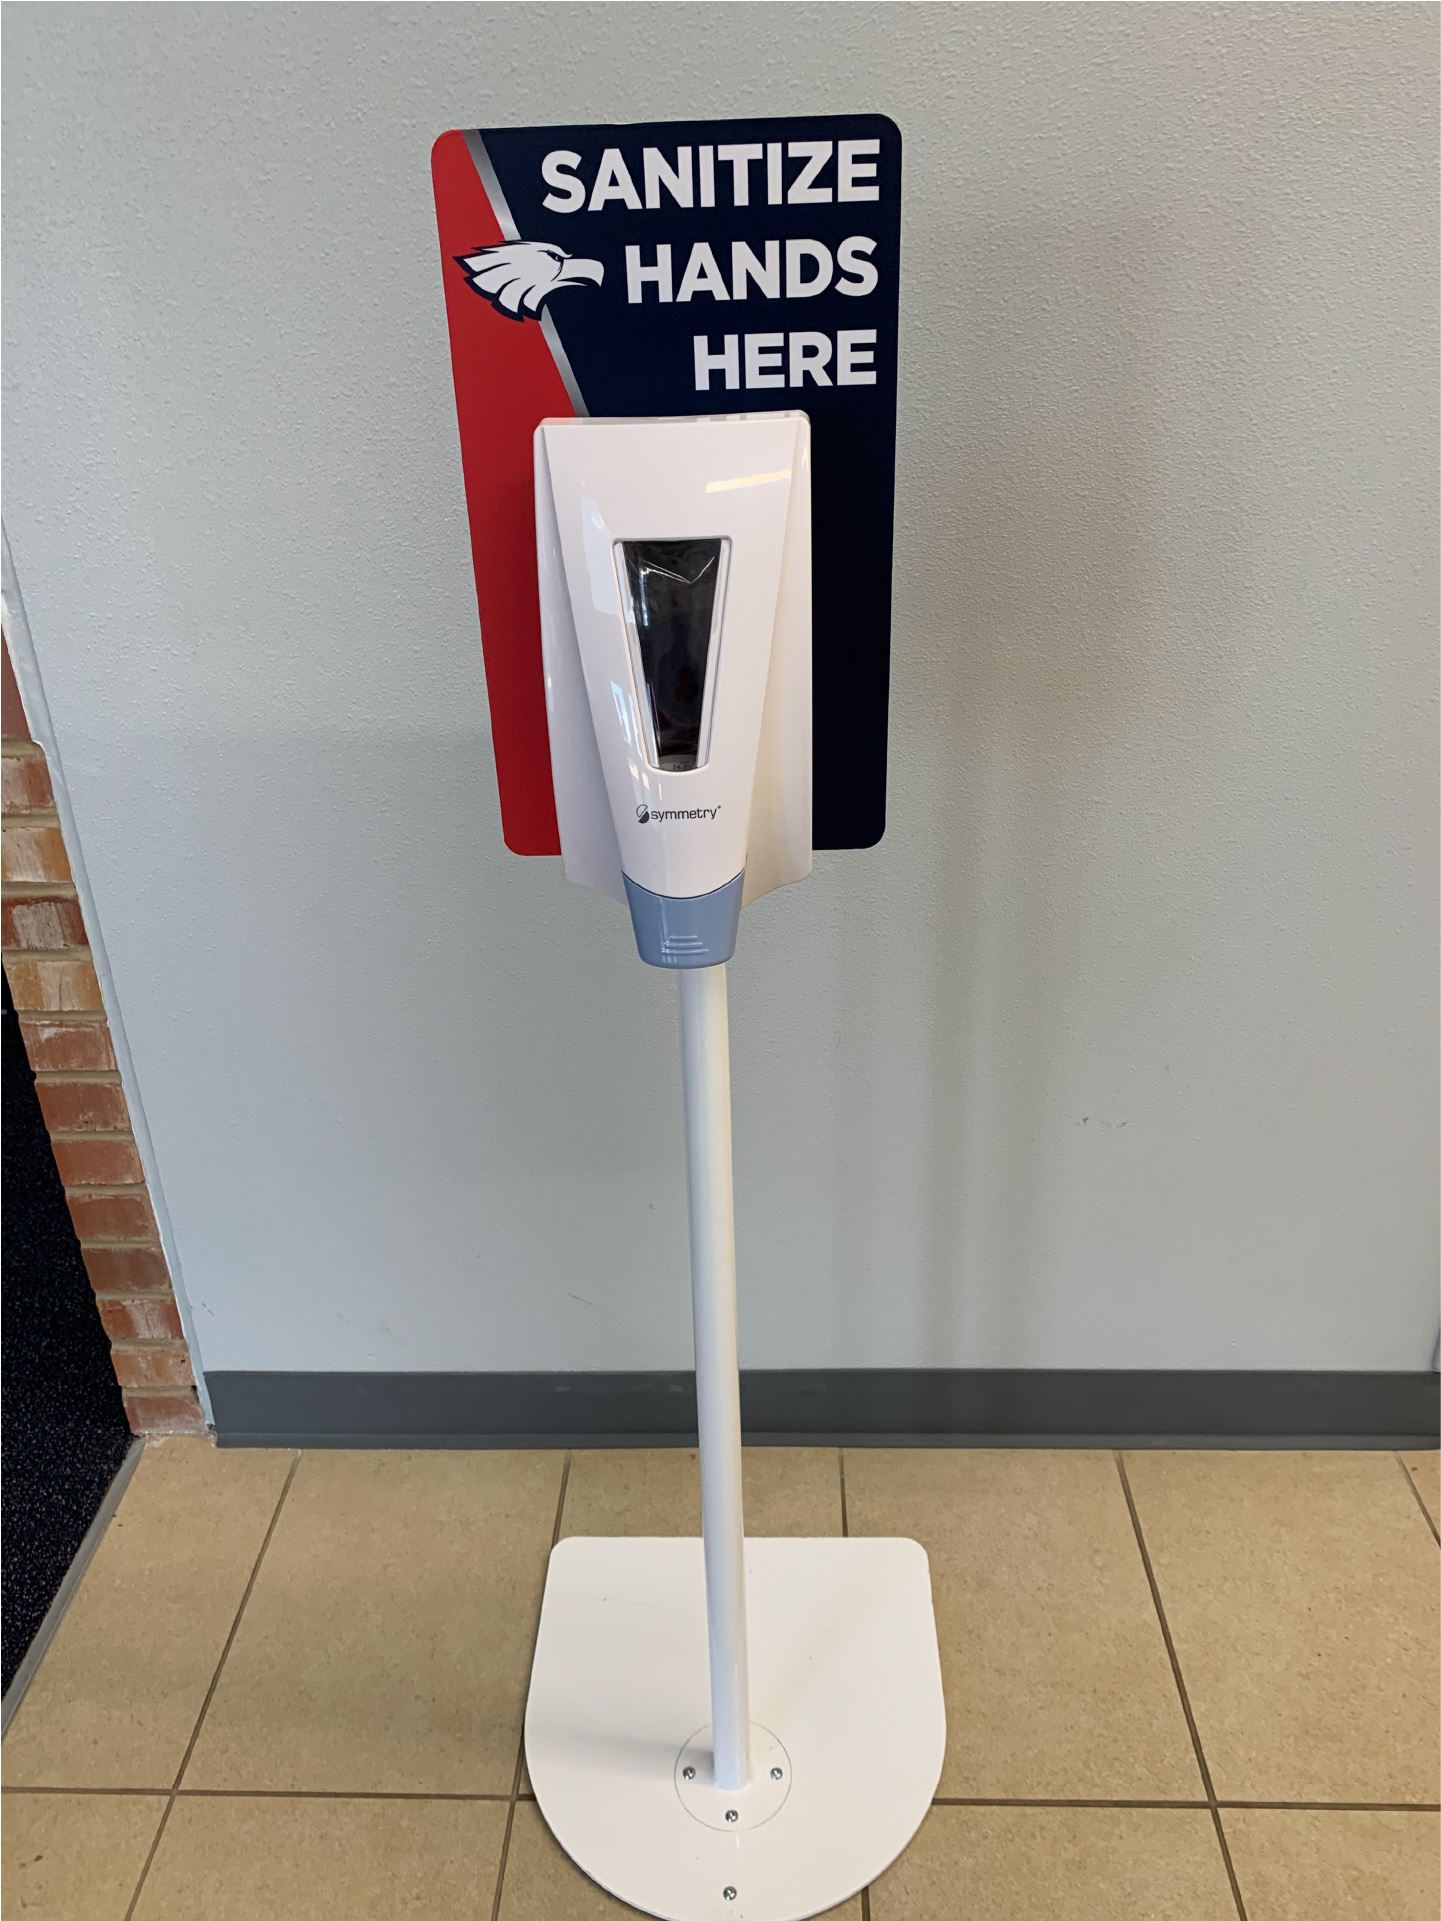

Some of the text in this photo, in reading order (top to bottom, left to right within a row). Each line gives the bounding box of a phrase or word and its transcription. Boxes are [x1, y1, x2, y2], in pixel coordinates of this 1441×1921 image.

[541, 138, 881, 214] SANITIZE
[625, 235, 879, 304] HANDS
[693, 328, 877, 391] HERE
[650, 807, 718, 823] symmetry
